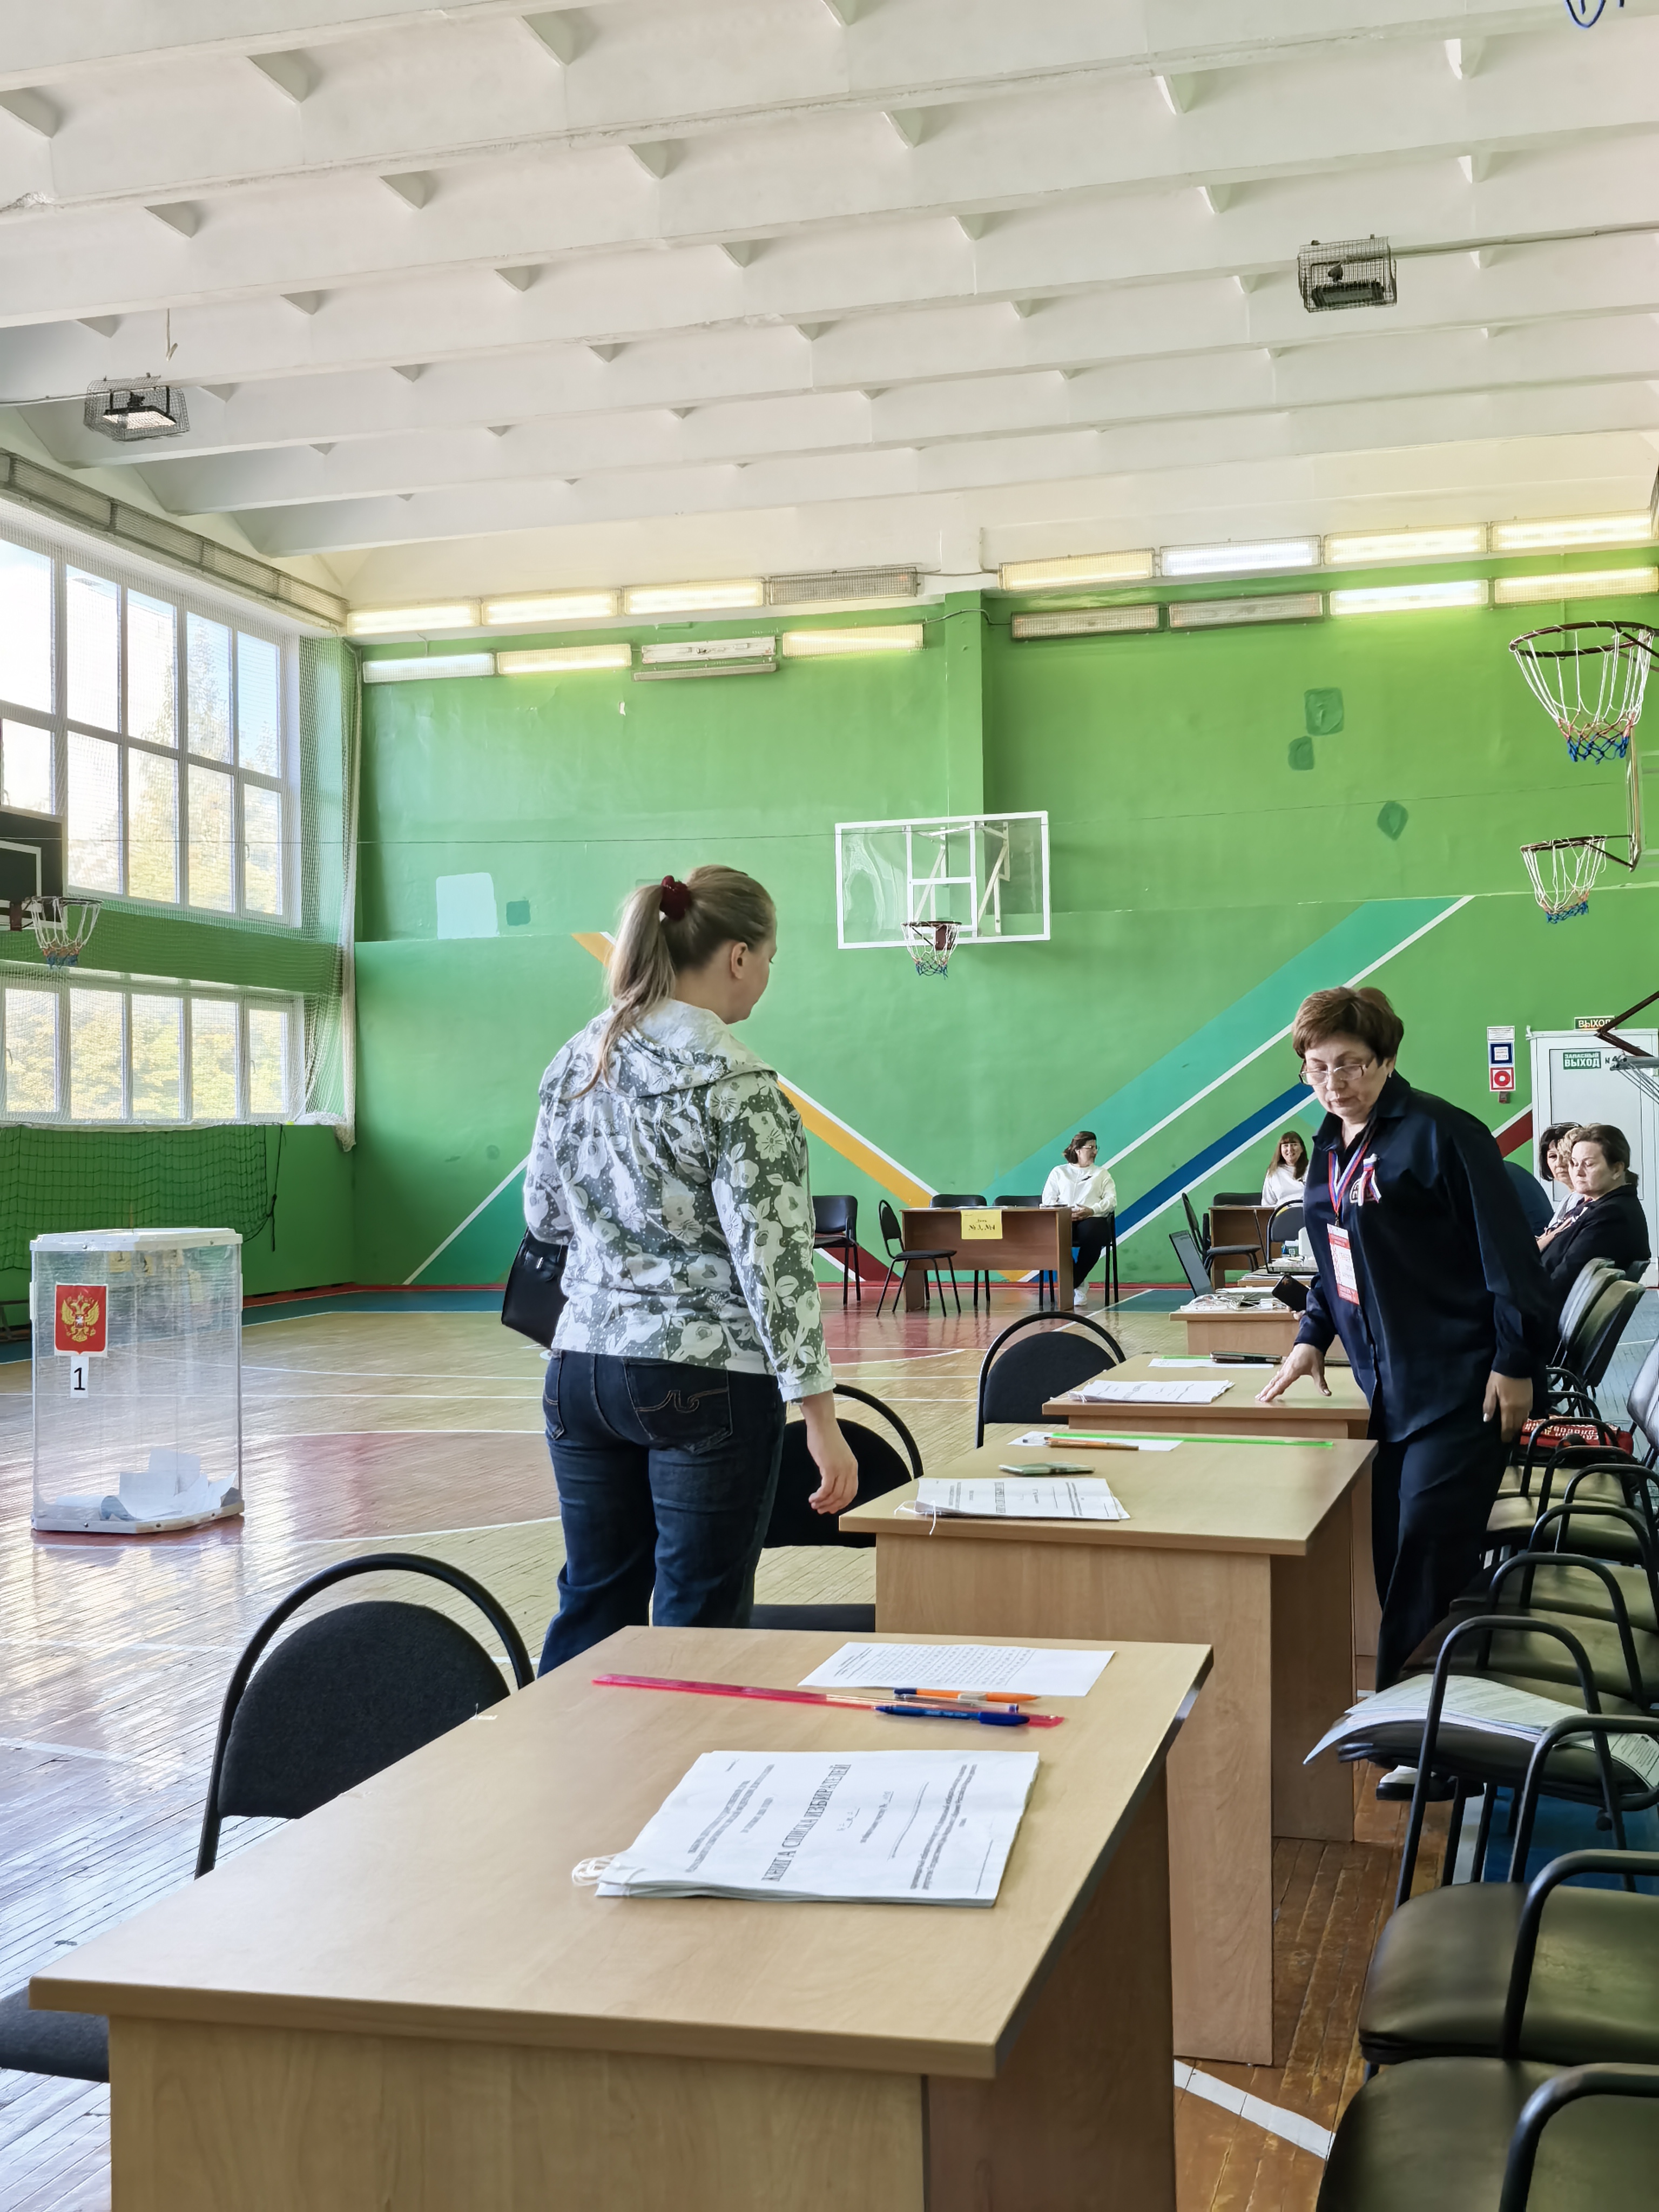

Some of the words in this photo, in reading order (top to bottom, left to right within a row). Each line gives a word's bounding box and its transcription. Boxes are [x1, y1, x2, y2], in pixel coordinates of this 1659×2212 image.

[1564, 1058, 1600, 1068] ВЫХОД
[74, 1367, 86, 1391] 1
[760, 1850, 797, 1882] КНИГА
[781, 1818, 819, 1848] СПИСКА
[803, 1764, 852, 1818] ИЗБИРАТЕЛЕЙ
